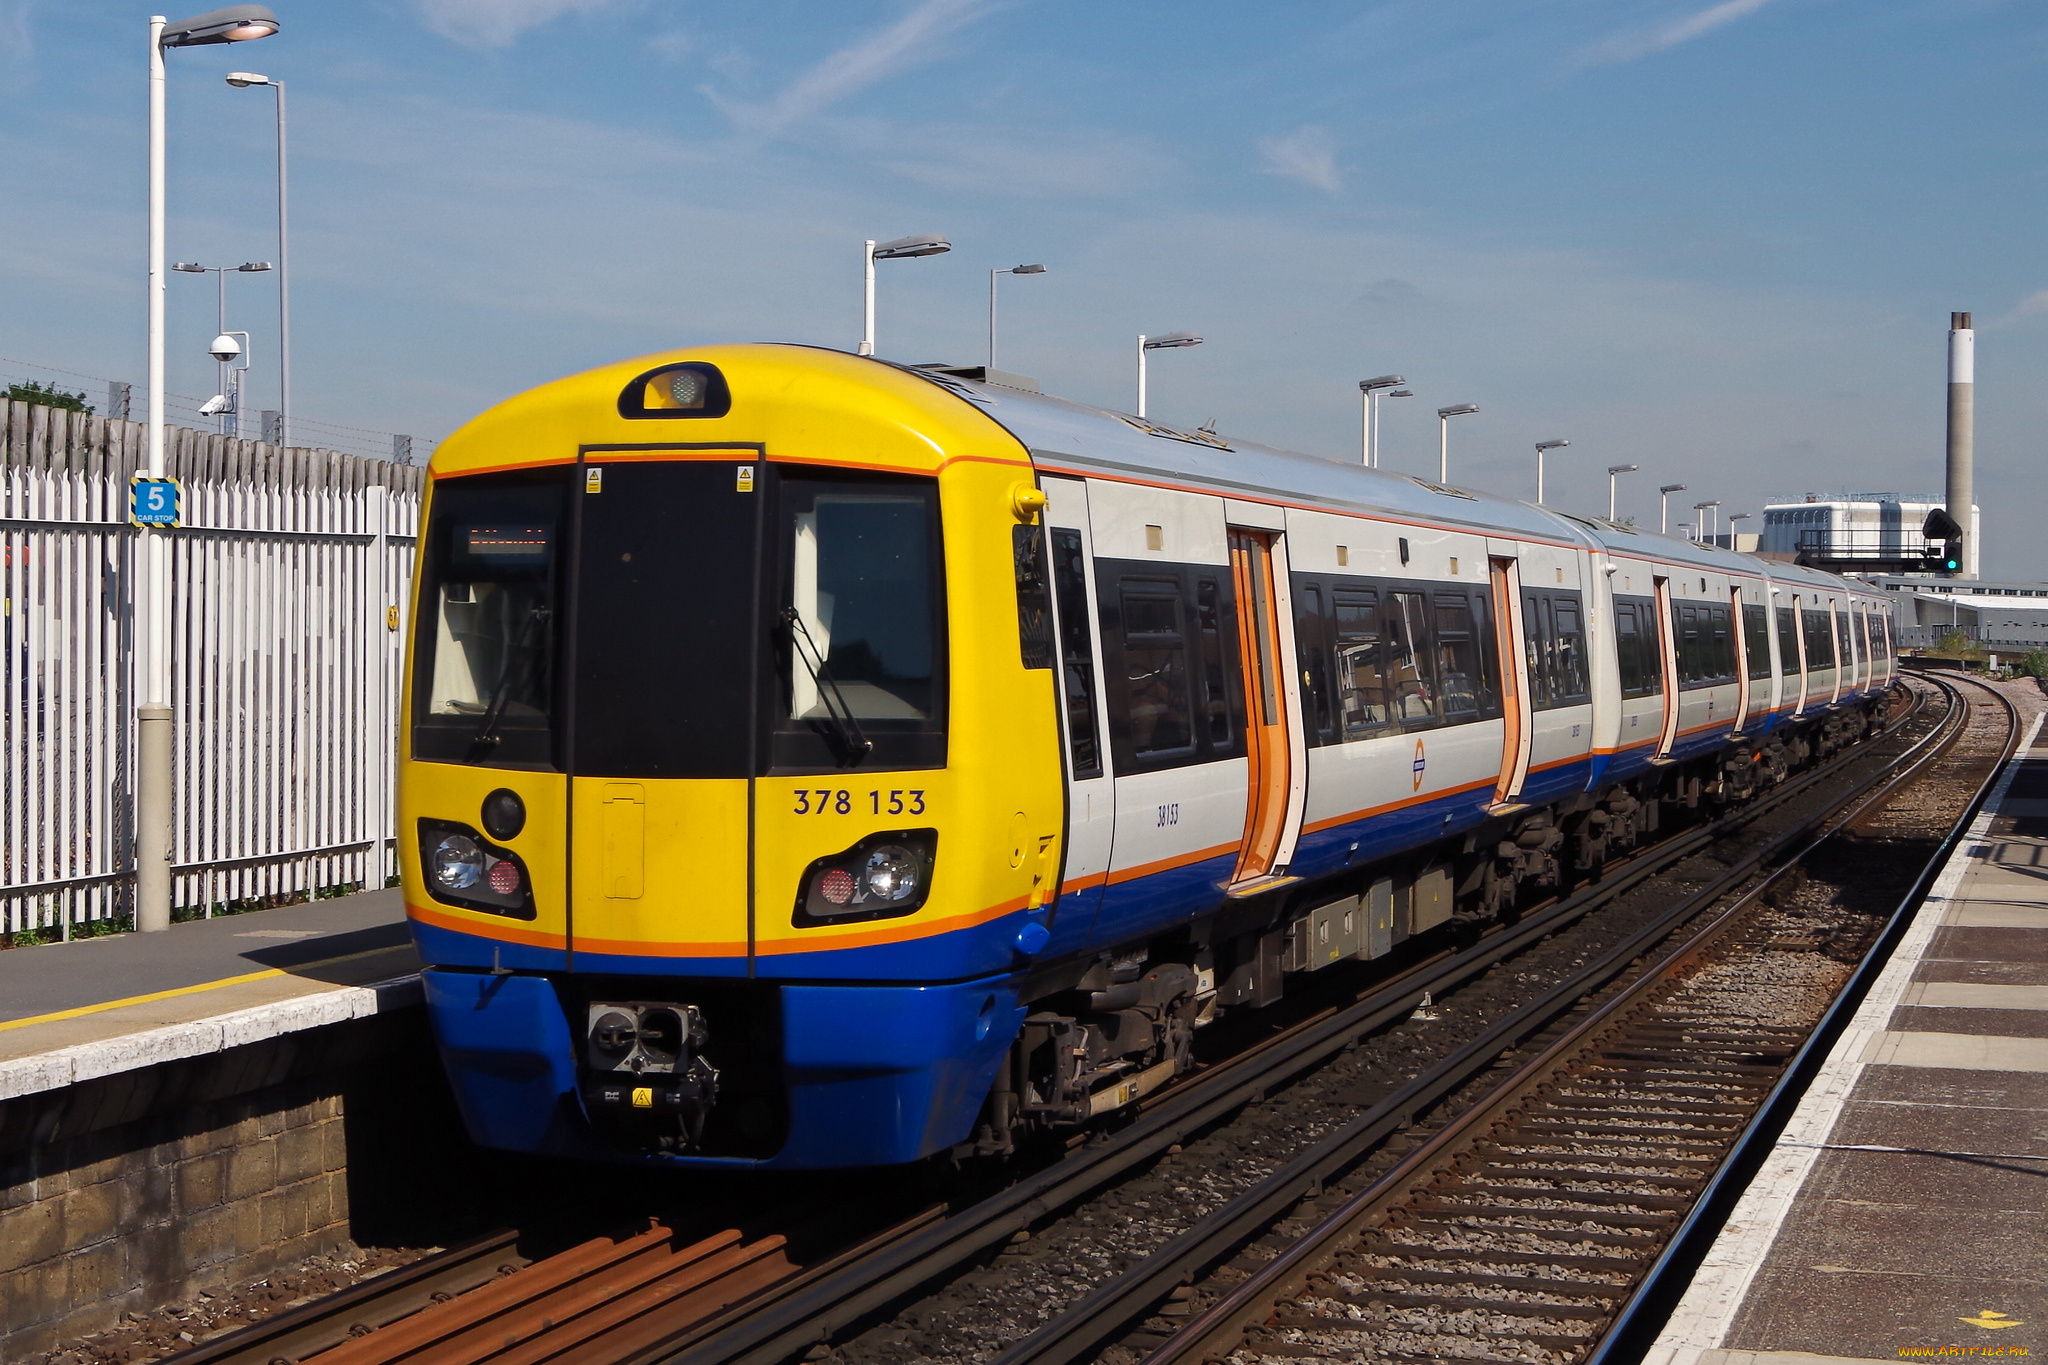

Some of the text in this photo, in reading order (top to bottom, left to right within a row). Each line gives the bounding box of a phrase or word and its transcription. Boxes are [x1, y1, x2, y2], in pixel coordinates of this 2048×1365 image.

[147, 486, 165, 511] 5
[793, 789, 926, 815] 378 153
[1157, 803, 1179, 828] 38153
